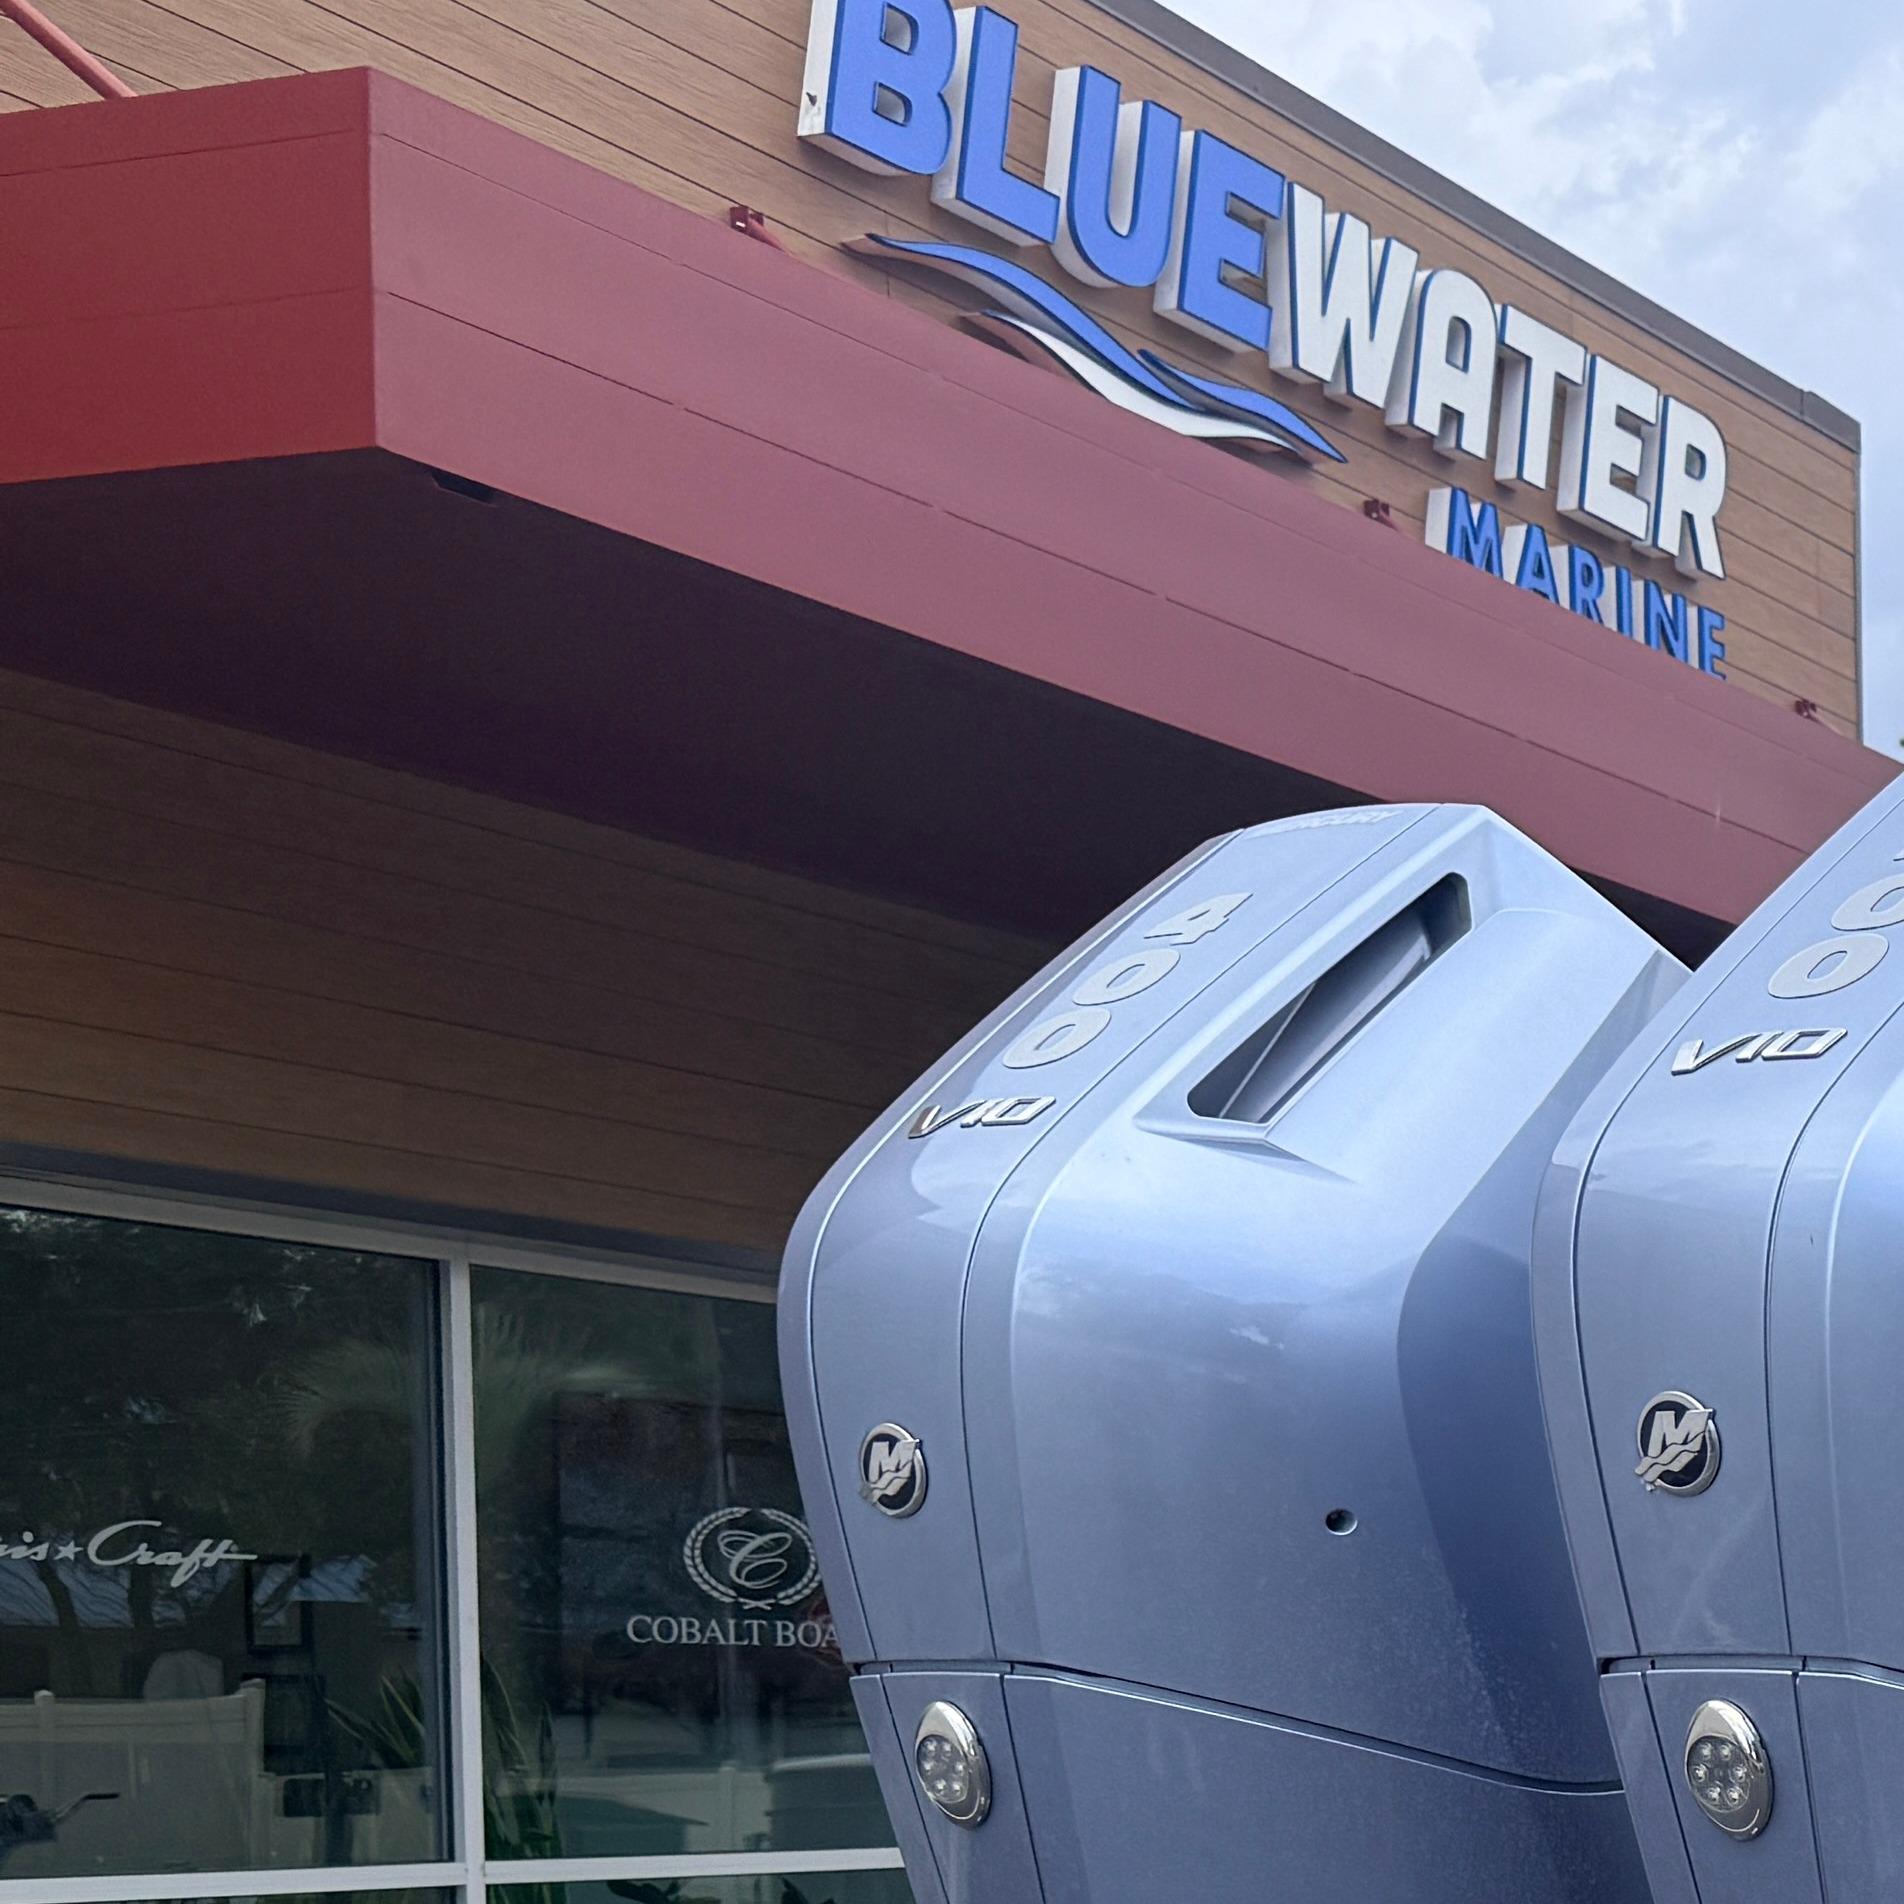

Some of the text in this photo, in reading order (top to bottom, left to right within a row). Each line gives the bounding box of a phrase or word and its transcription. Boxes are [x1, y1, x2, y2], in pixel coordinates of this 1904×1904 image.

[1426, 486, 1727, 681] MARINE
[1000, 892, 1252, 1069] 400
[1671, 1026, 1848, 1075] V10
[908, 1095, 1056, 1139] V10
[87, 1519, 258, 1588] Craft
[626, 1614, 840, 1648] COBALT BOA
